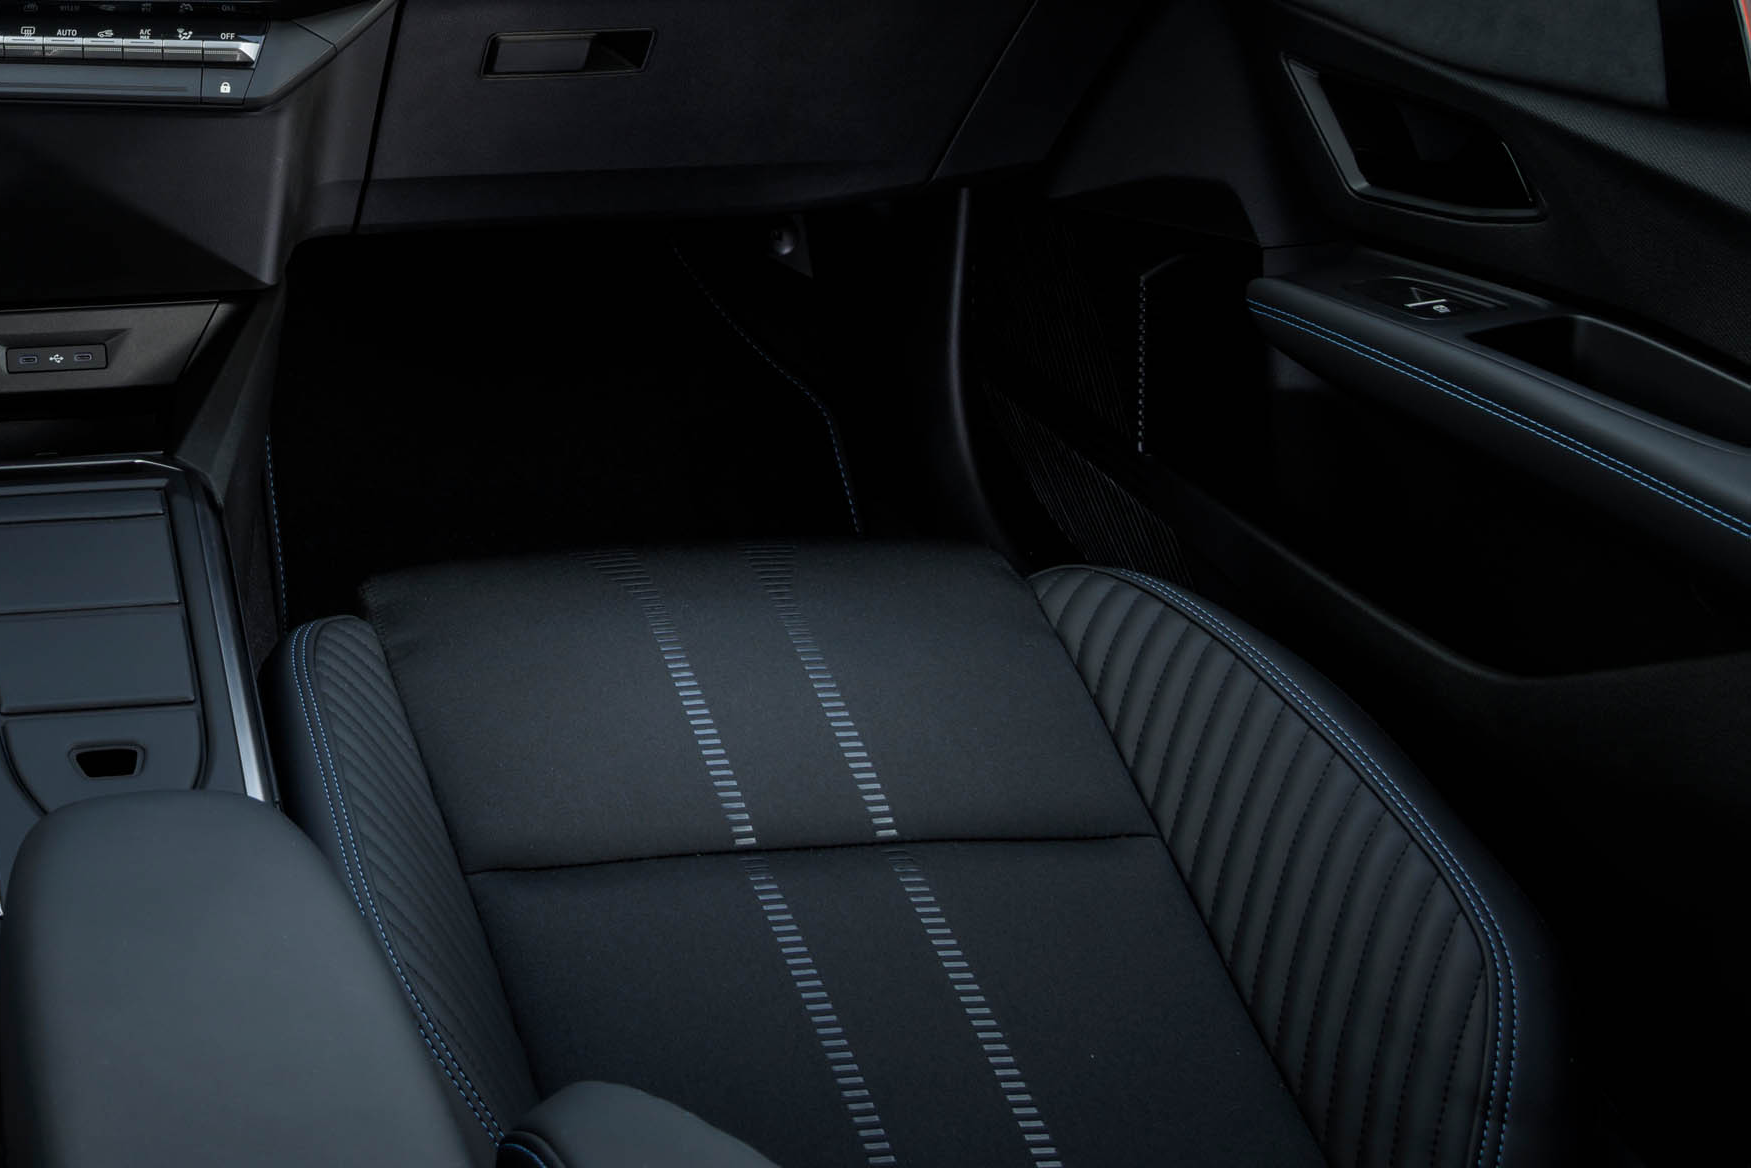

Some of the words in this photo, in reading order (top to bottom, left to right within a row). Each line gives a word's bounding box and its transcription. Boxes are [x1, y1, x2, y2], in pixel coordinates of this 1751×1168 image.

[57, 29, 78, 37] AUTO
[139, 28, 152, 36] A/C
[220, 32, 236, 40] OFF
